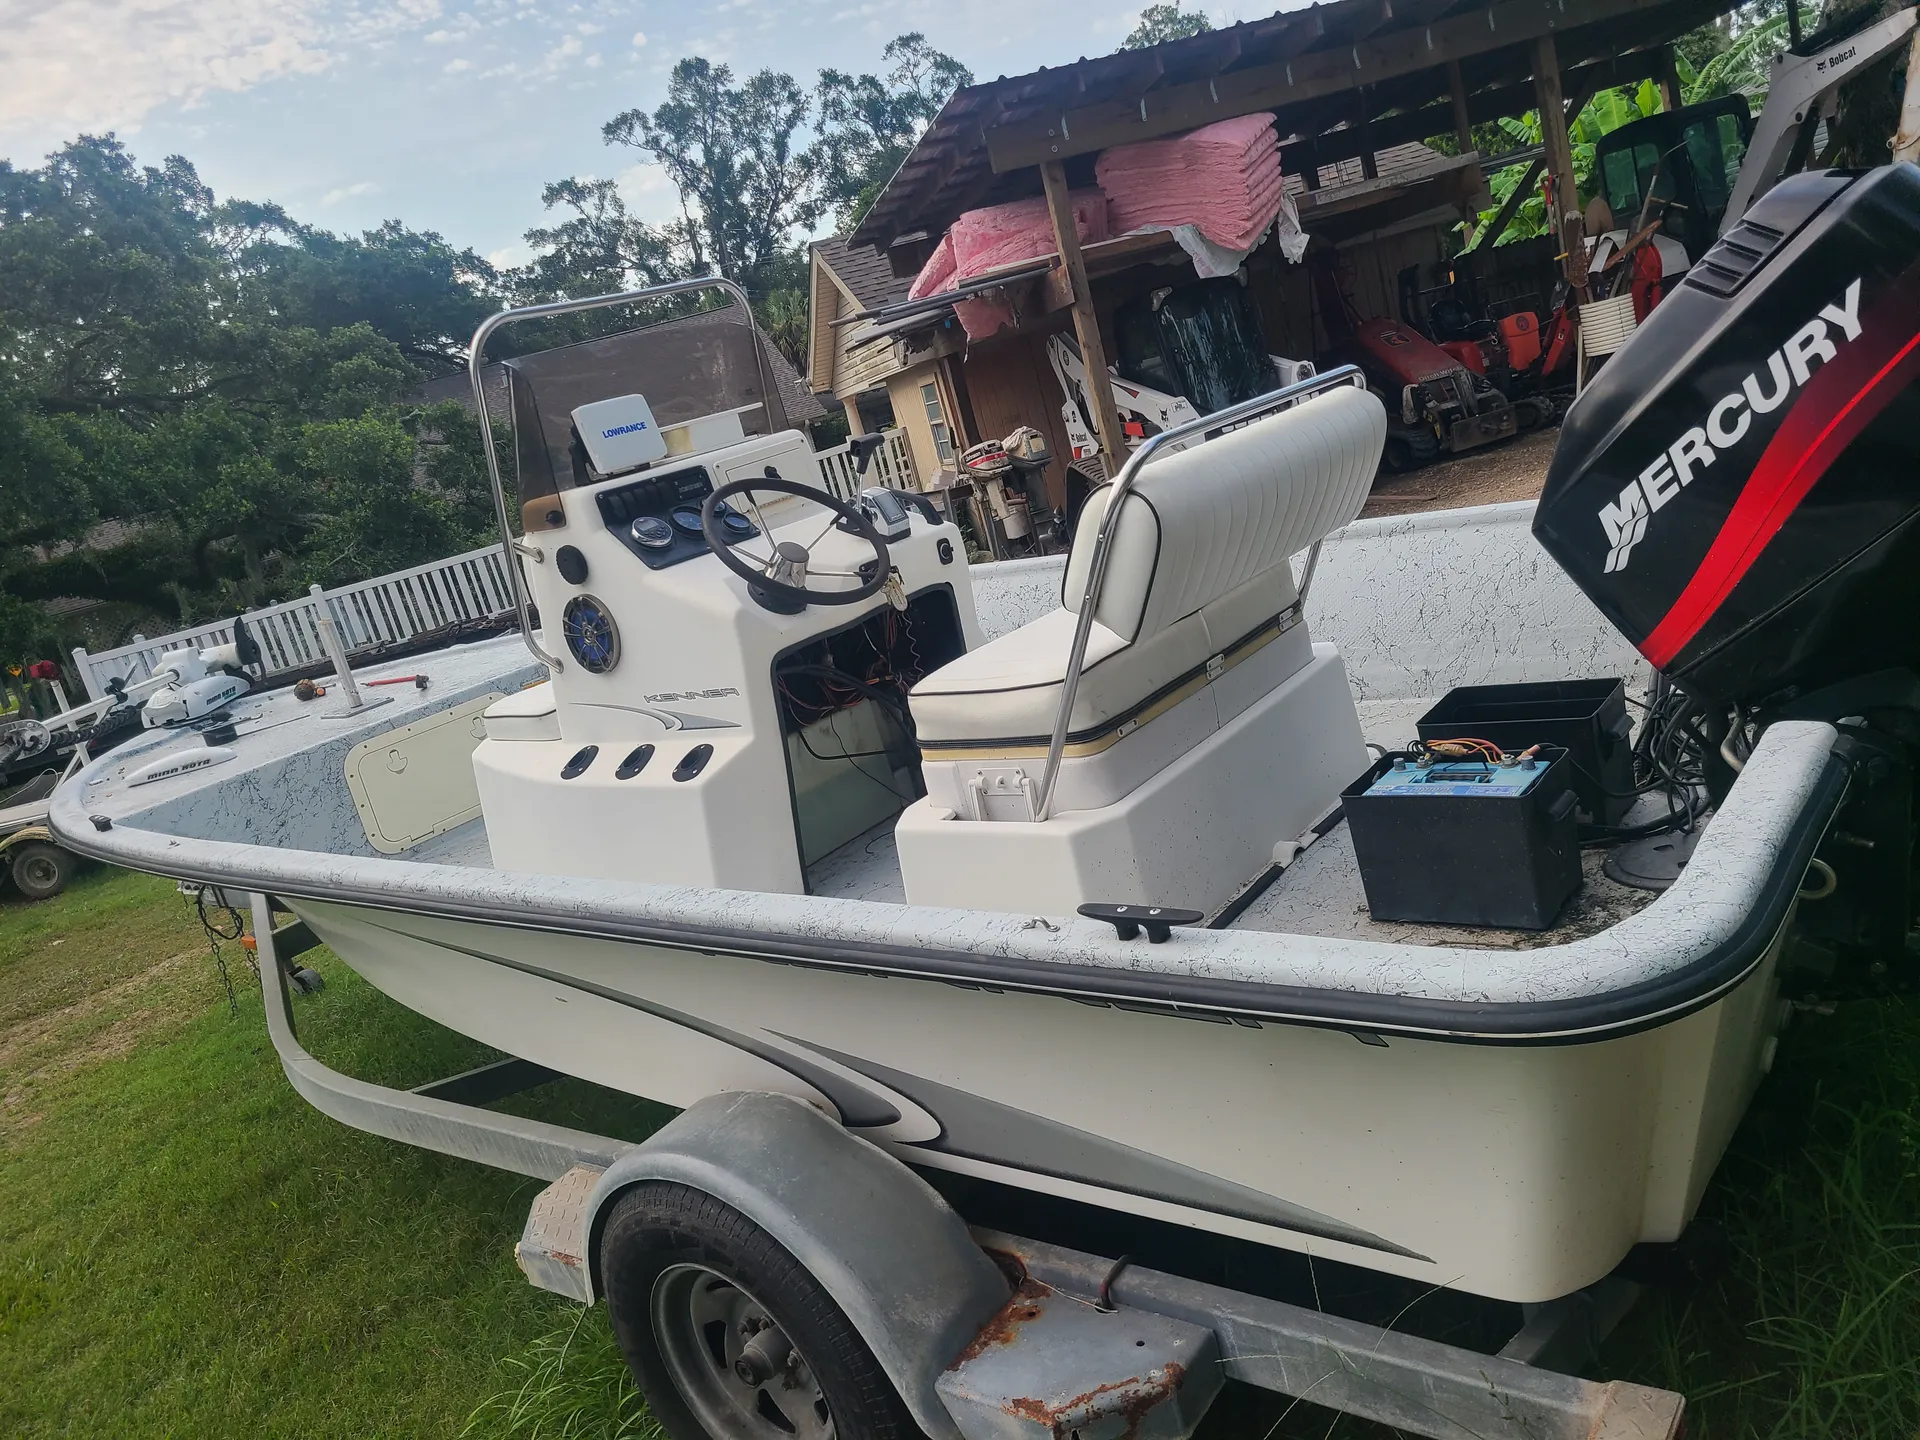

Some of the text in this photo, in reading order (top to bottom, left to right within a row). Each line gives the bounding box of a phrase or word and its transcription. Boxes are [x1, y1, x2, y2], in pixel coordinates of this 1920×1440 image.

[1829, 46, 1857, 68] Bobcat
[602, 421, 648, 439] LOWRANCE
[1598, 277, 1863, 574] MERCURY
[643, 687, 740, 704] KENNER
[181, 758, 211, 771] KOTA
